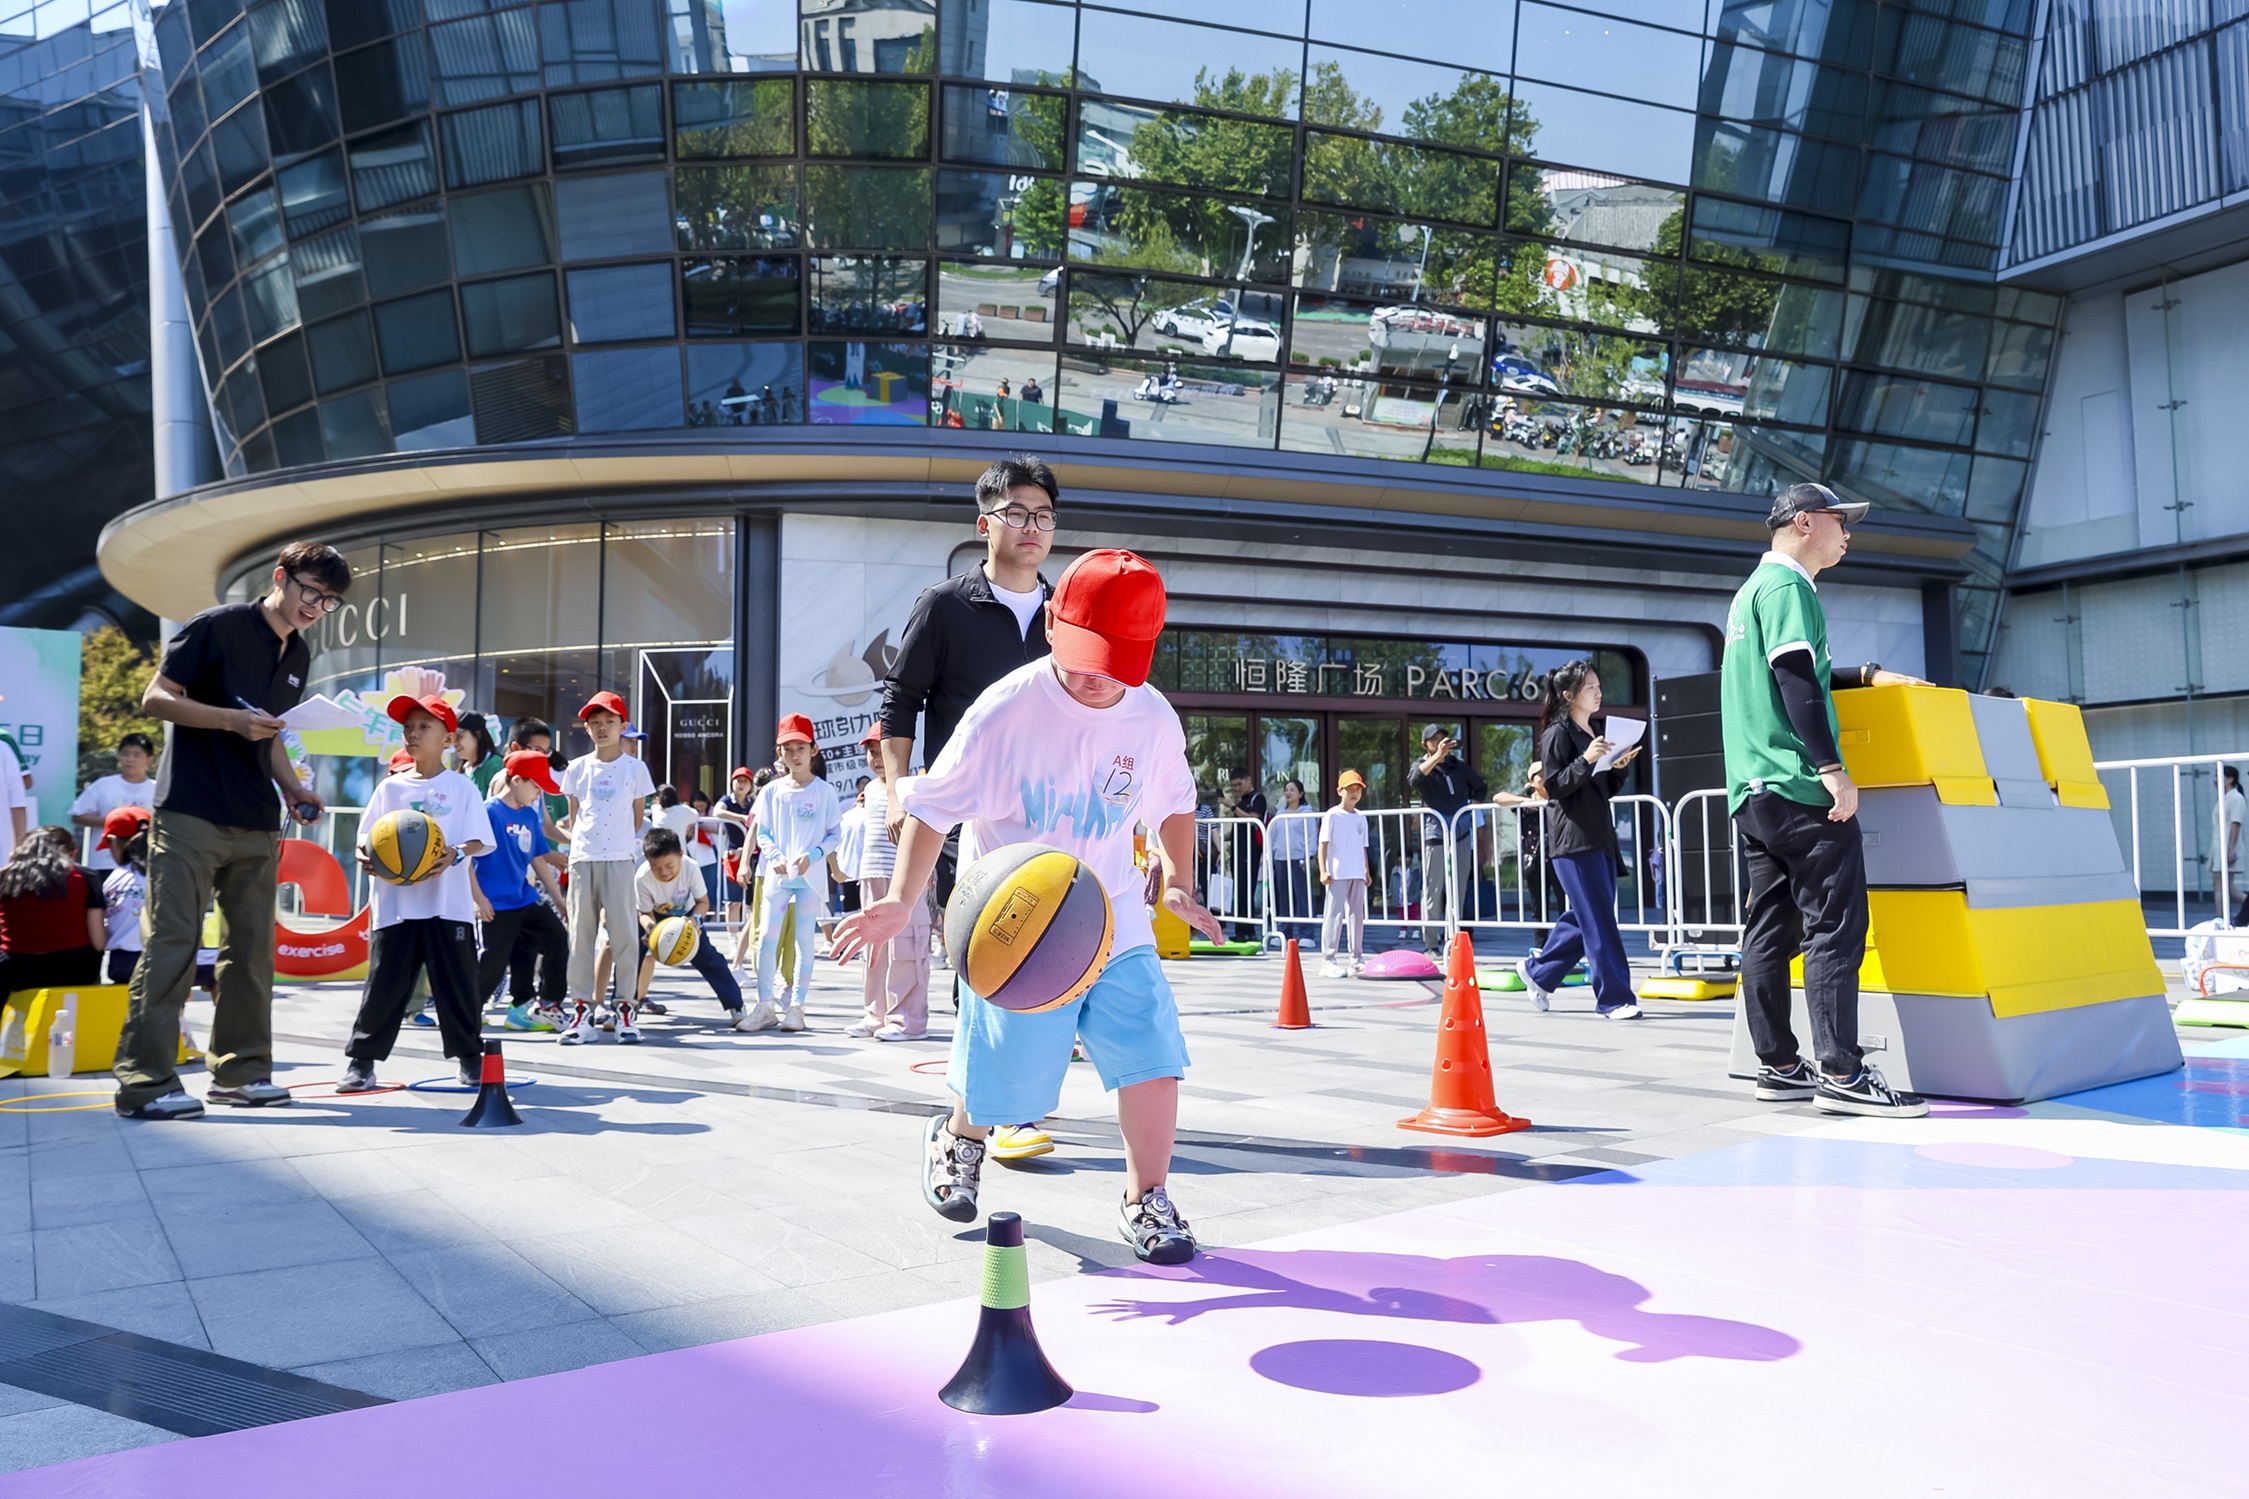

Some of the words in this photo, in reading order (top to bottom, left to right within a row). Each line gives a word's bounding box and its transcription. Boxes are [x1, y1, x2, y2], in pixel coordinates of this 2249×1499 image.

[1235, 657, 1384, 696] 恒隆广场
[1406, 664, 1509, 700] PARC
[679, 719, 719, 727] GUCCI
[1112, 755, 1134, 770] A组
[1103, 768, 1132, 797] 12
[277, 943, 346, 958] exercise
